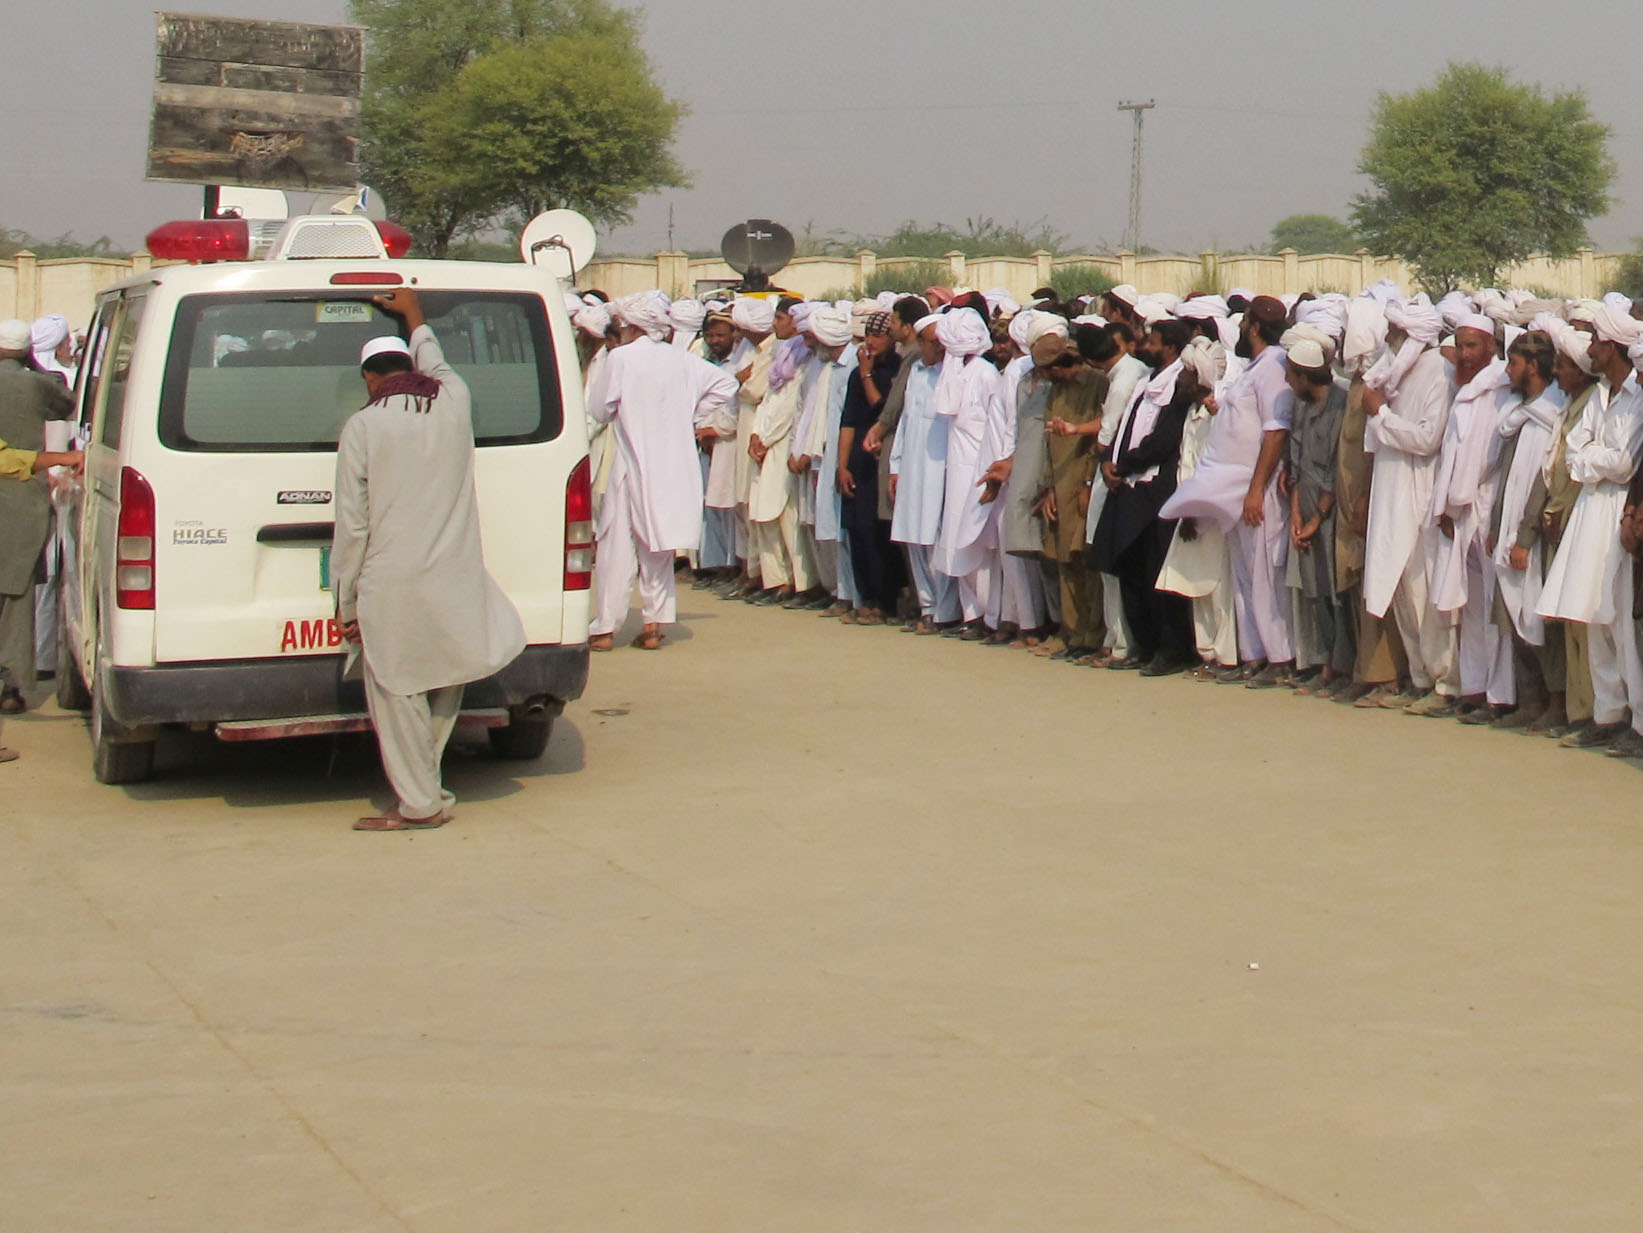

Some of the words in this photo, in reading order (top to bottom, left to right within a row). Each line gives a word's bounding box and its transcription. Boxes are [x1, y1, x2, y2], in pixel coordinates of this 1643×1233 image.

[324, 305, 365, 314] CAPITAL
[280, 492, 331, 501] ADNAN
[173, 528, 228, 539] HIACE
